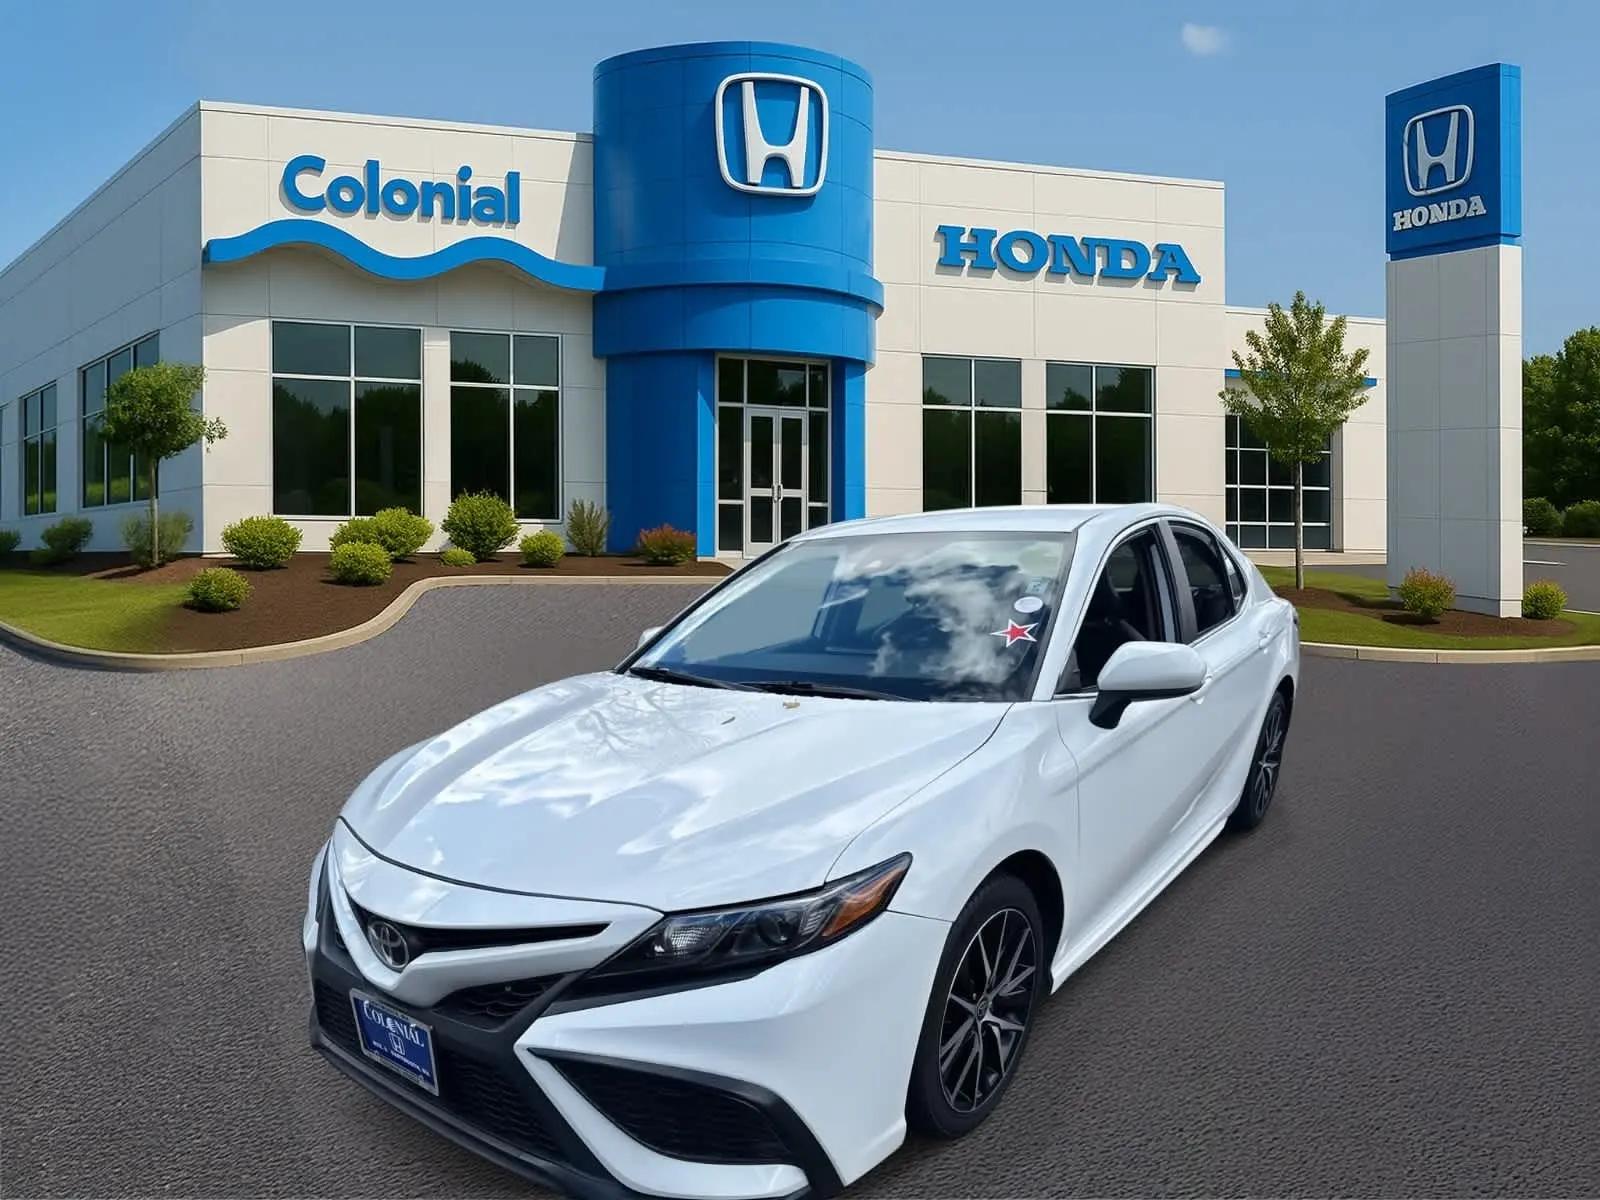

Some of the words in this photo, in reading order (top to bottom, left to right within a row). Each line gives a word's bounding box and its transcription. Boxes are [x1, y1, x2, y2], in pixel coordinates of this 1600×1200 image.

[281, 154, 520, 225] Colonial
[1393, 195, 1486, 231] HONDA
[936, 225, 1201, 284] HONDA
[363, 1000, 424, 1047] COLONIAL
